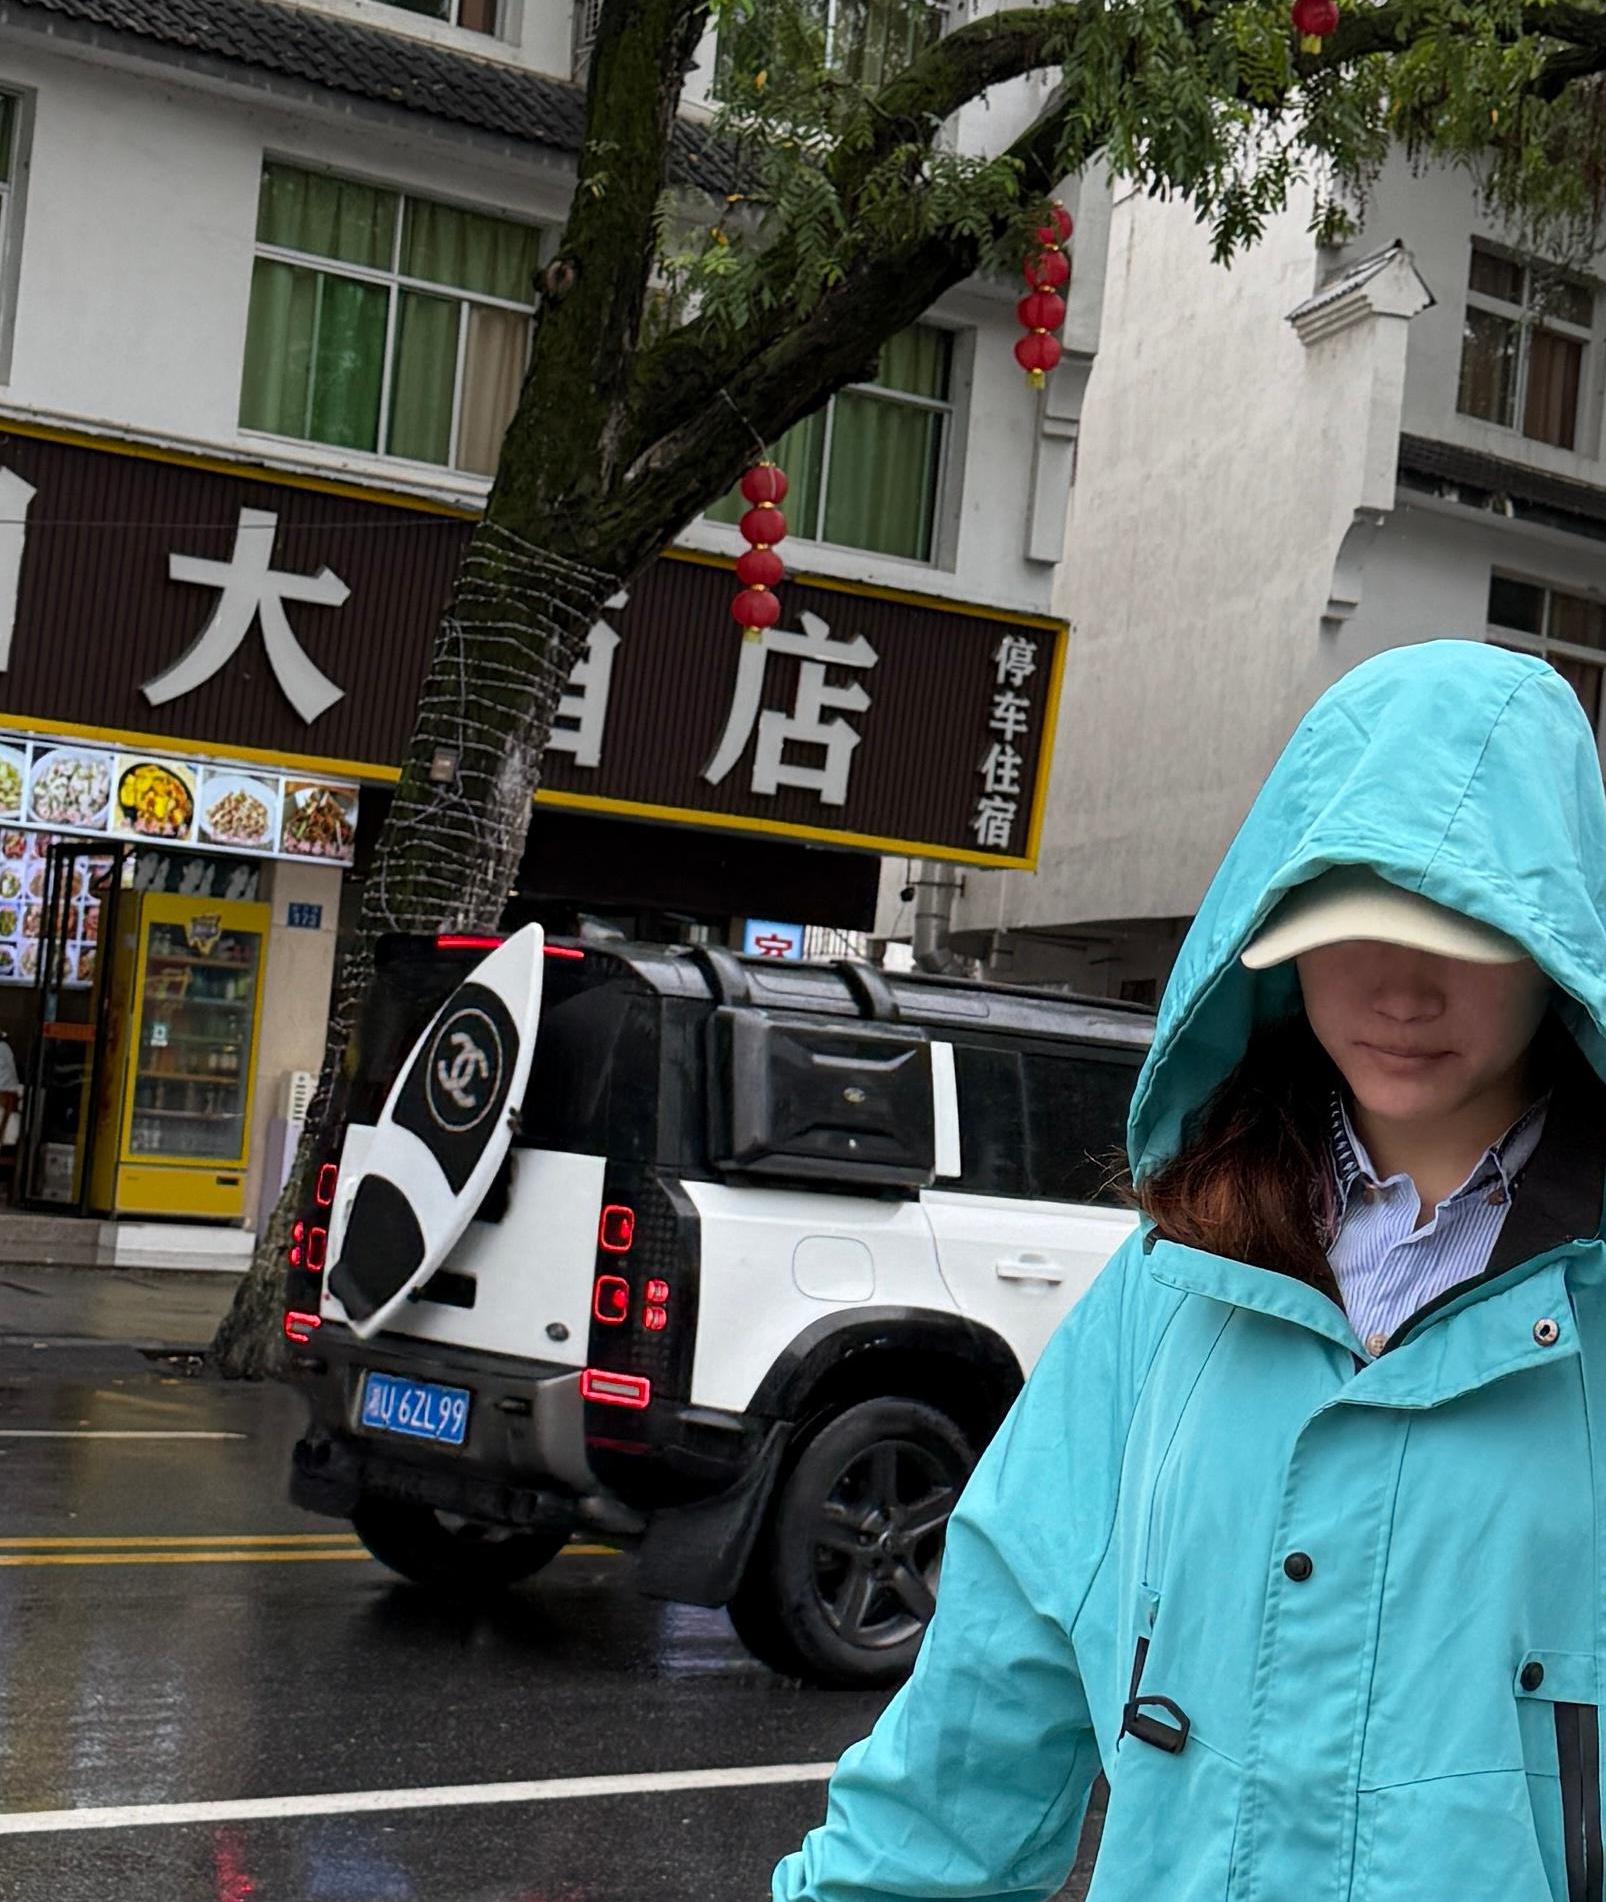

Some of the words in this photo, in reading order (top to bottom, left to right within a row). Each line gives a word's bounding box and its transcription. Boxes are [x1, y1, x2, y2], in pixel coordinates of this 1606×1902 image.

[0, 466, 878, 805] 大店
[973, 634, 1037, 848] 停车住宿
